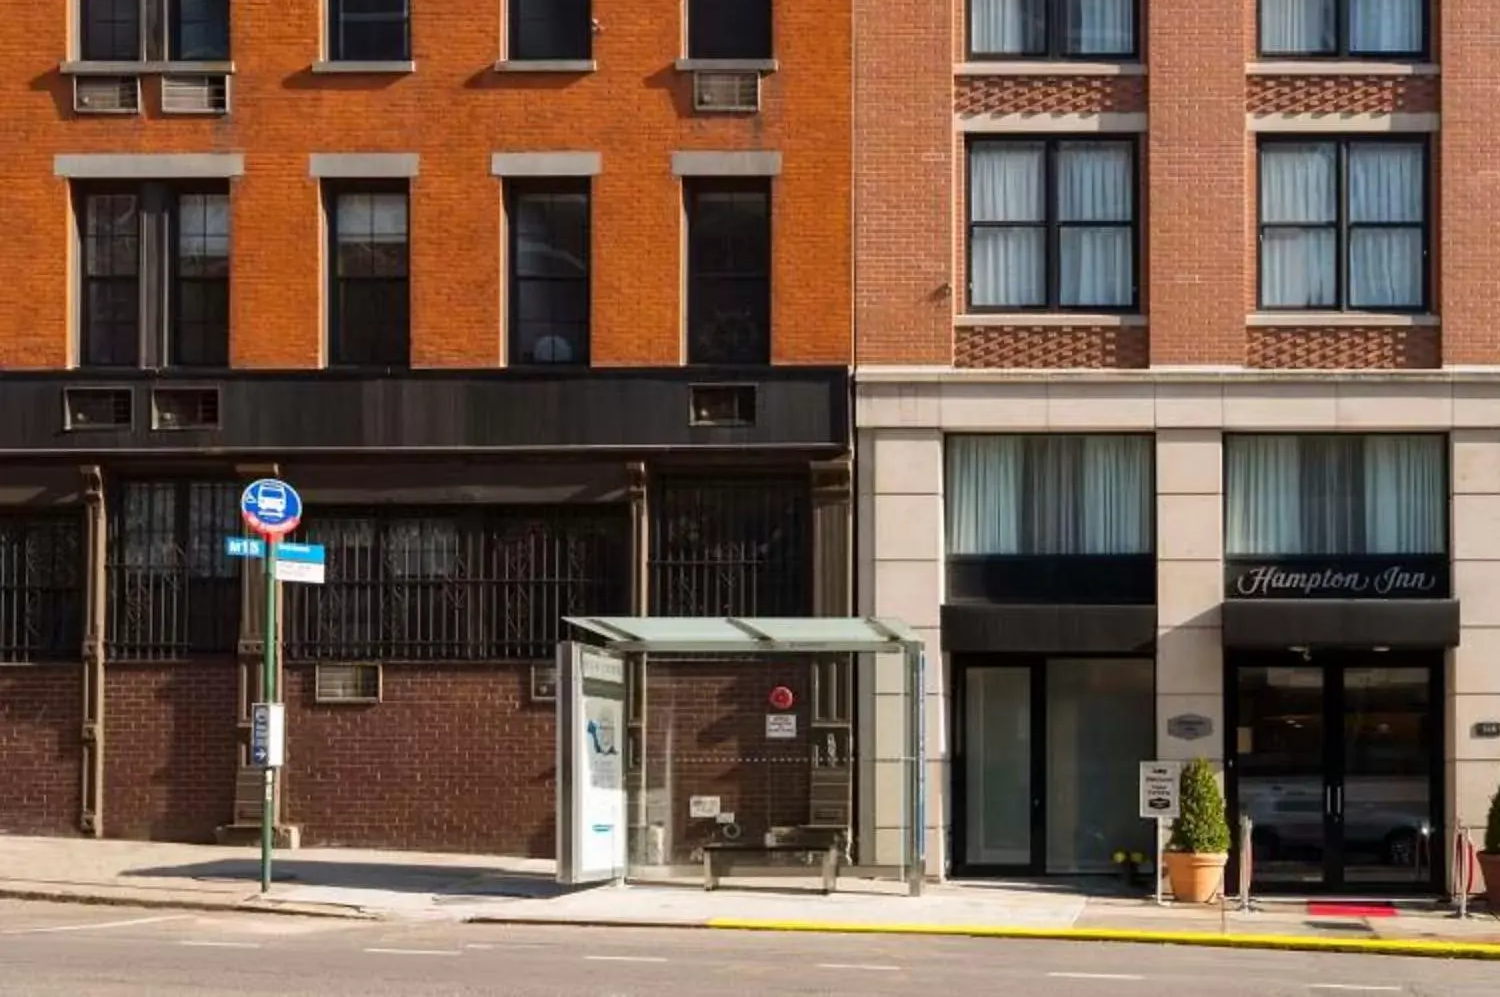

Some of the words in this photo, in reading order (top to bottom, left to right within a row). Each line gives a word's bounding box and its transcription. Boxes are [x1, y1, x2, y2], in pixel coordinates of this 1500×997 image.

[229, 540, 260, 554] M15
[1237, 566, 1370, 595] Hampton
[1373, 565, 1436, 594] Inn
